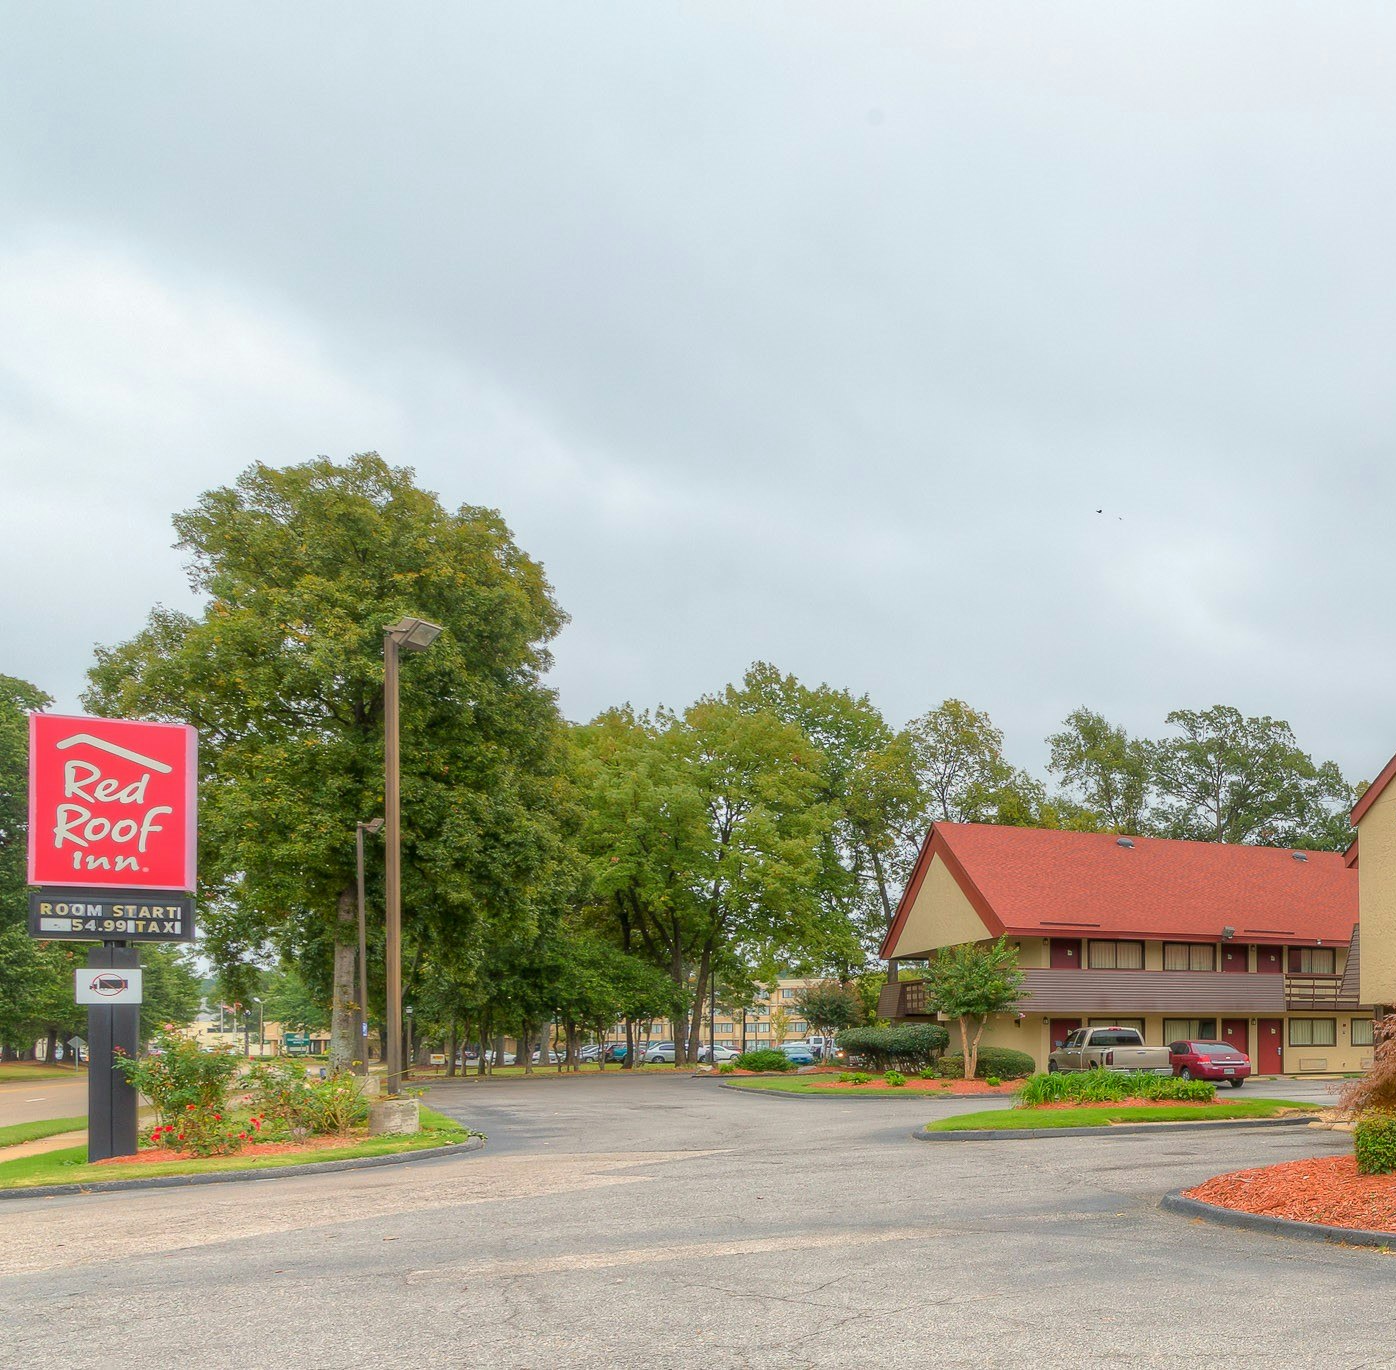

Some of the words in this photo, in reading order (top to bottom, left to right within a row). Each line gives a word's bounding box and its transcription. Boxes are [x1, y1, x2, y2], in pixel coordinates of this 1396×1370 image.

[64, 760, 150, 804] Red
[53, 803, 173, 852] Roof
[40, 902, 103, 916] ROOM
[71, 919, 127, 932] 54.99
